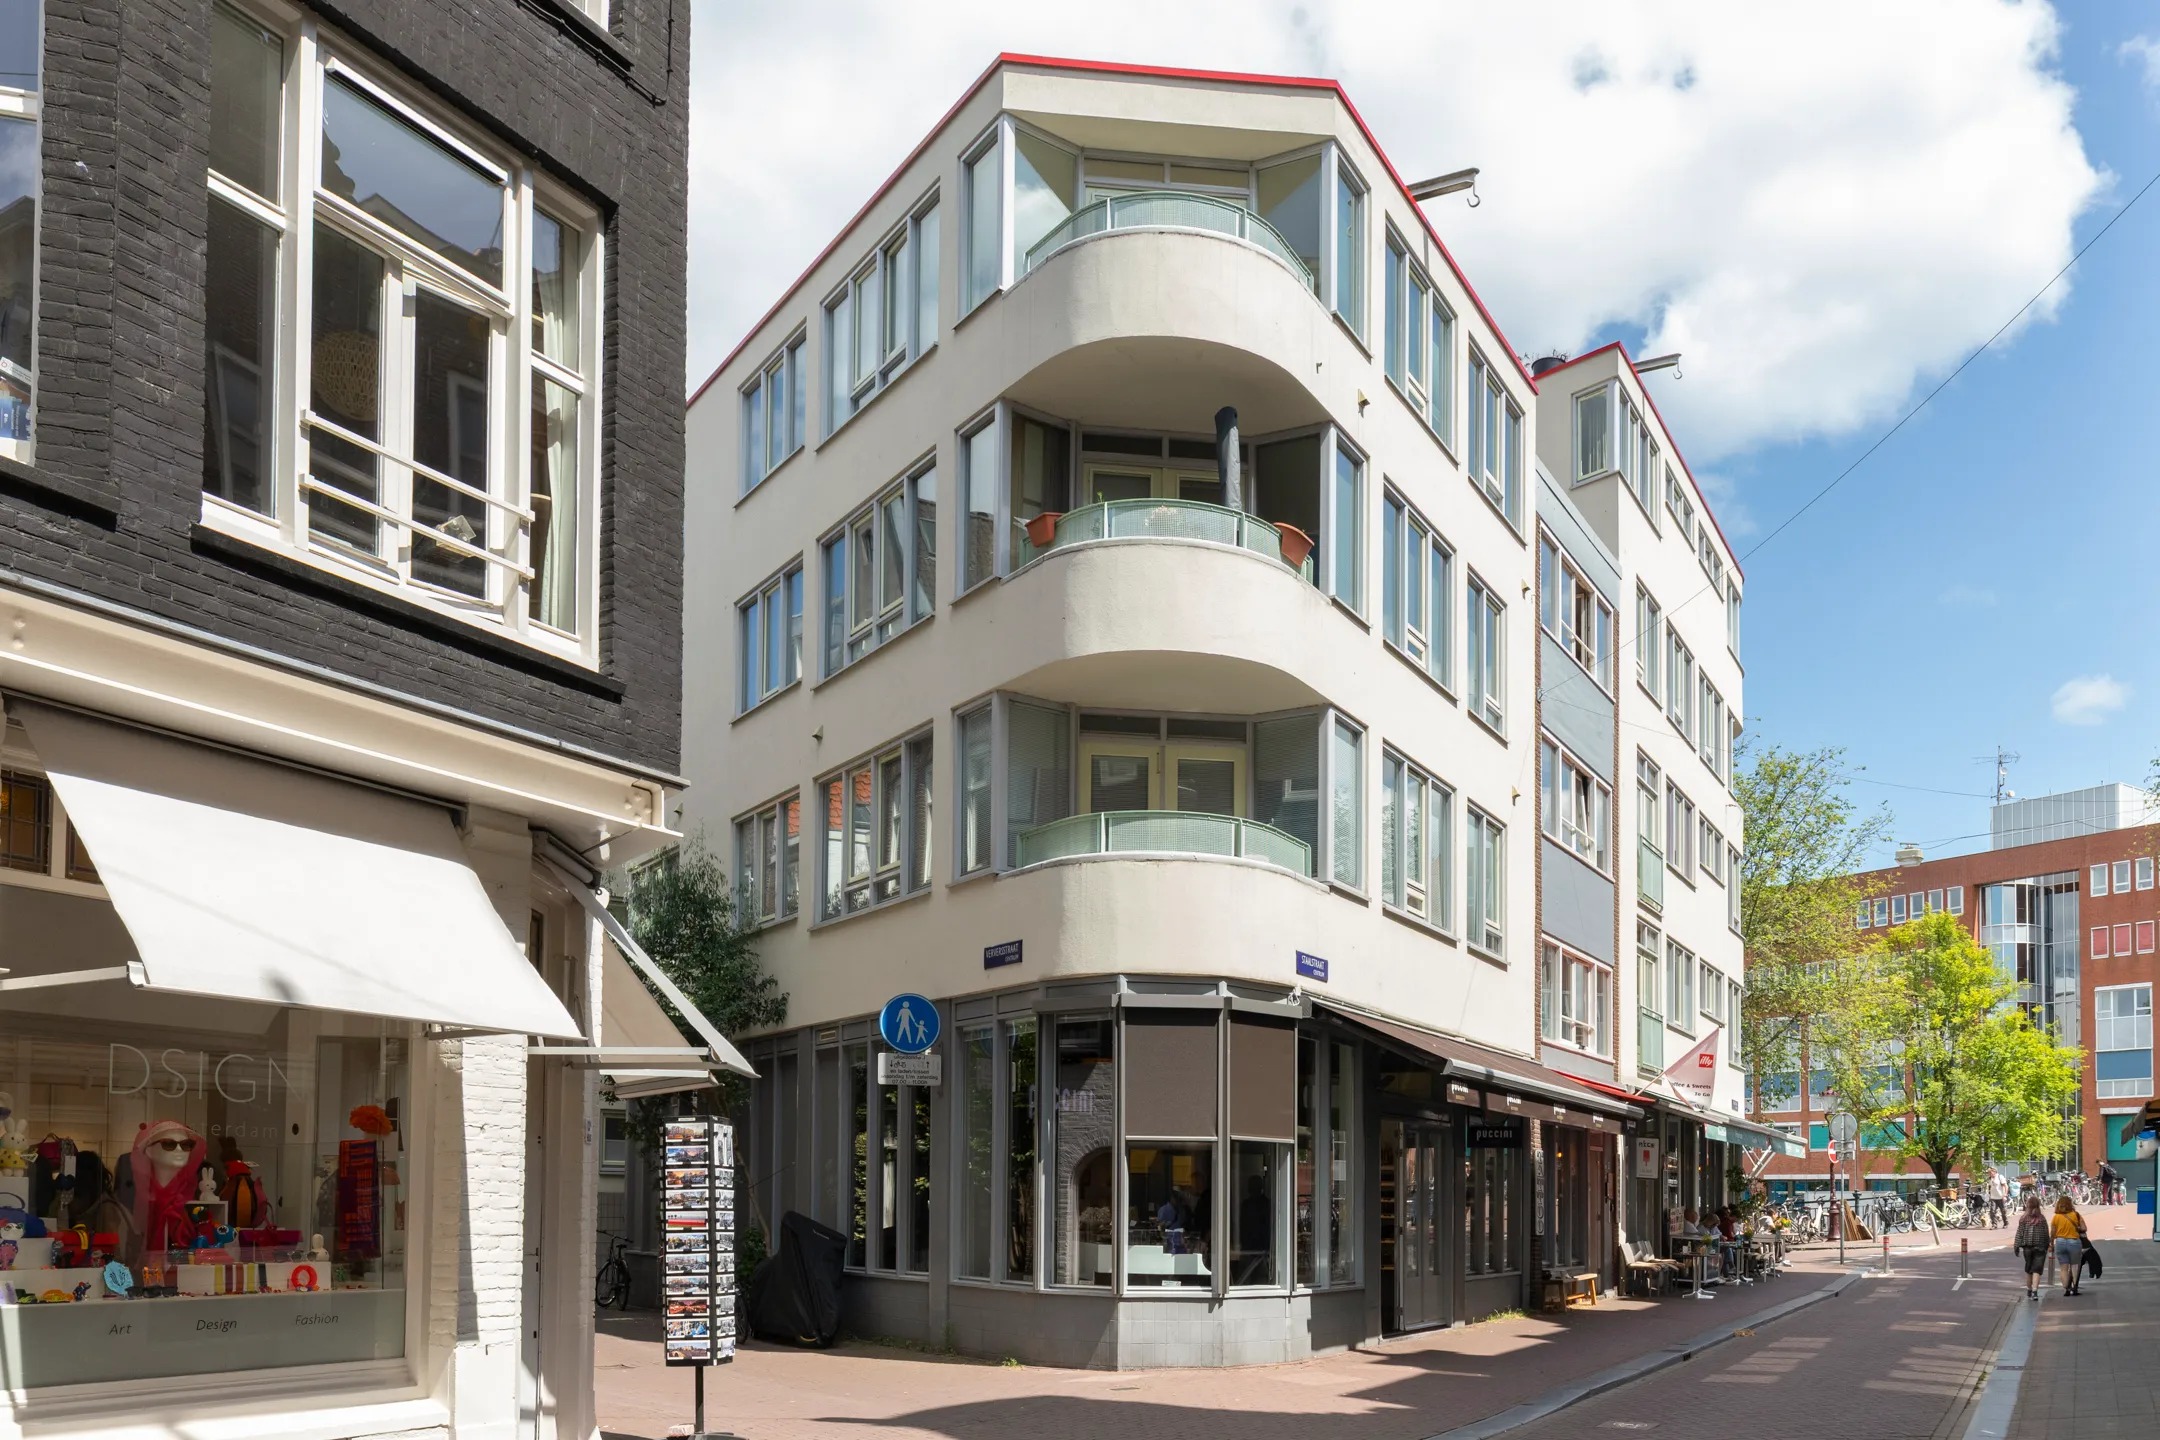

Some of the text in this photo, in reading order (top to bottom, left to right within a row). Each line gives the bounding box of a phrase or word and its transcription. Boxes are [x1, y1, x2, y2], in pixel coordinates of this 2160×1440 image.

[1700, 1055, 1713, 1067] illy
[109, 1043, 304, 1105] DSIGN
[1475, 1129, 1514, 1141] puccini
[109, 1314, 340, 1336] Art Design Fashion
